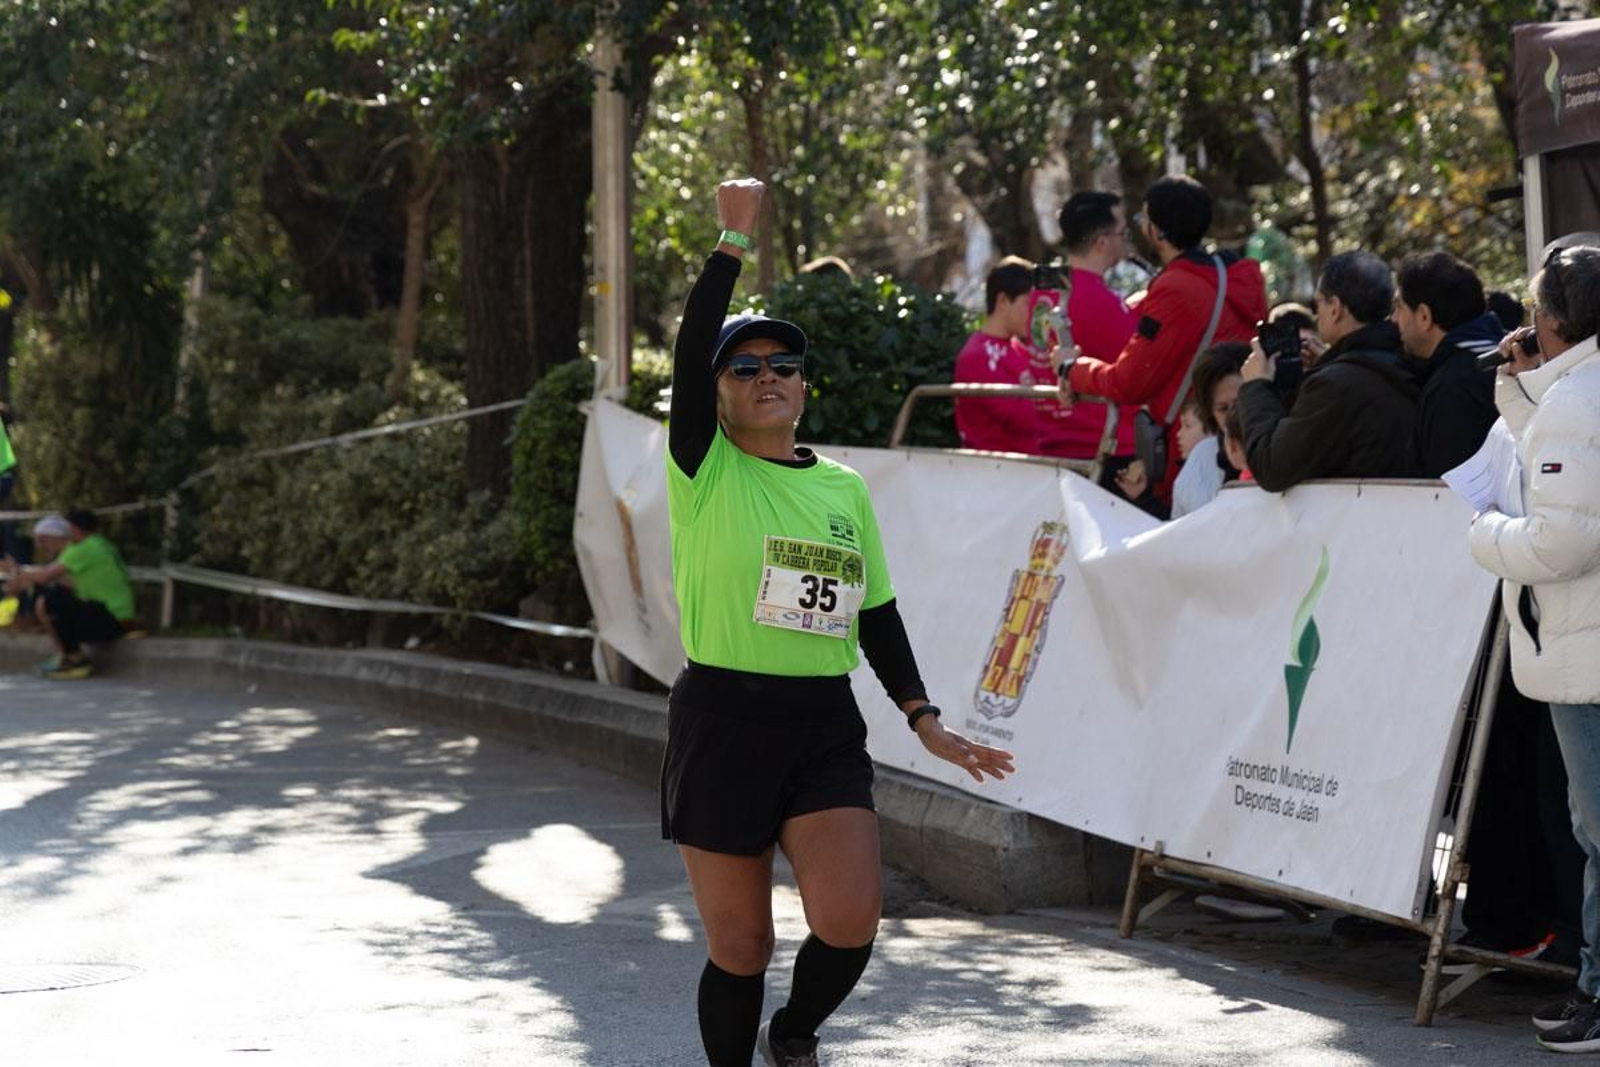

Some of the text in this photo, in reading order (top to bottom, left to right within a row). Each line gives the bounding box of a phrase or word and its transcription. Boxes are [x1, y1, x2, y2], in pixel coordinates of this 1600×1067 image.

[782, 554, 810, 570] CARRERA
[812, 558, 838, 573] POPULAR
[788, 542, 802, 554] SAN
[805, 545, 824, 558] JUAN
[798, 574, 838, 613] 35
[1279, 765, 1324, 796] Municipal
[1325, 776, 1339, 797] de
[1235, 785, 1319, 823] Deportes de Jaén
